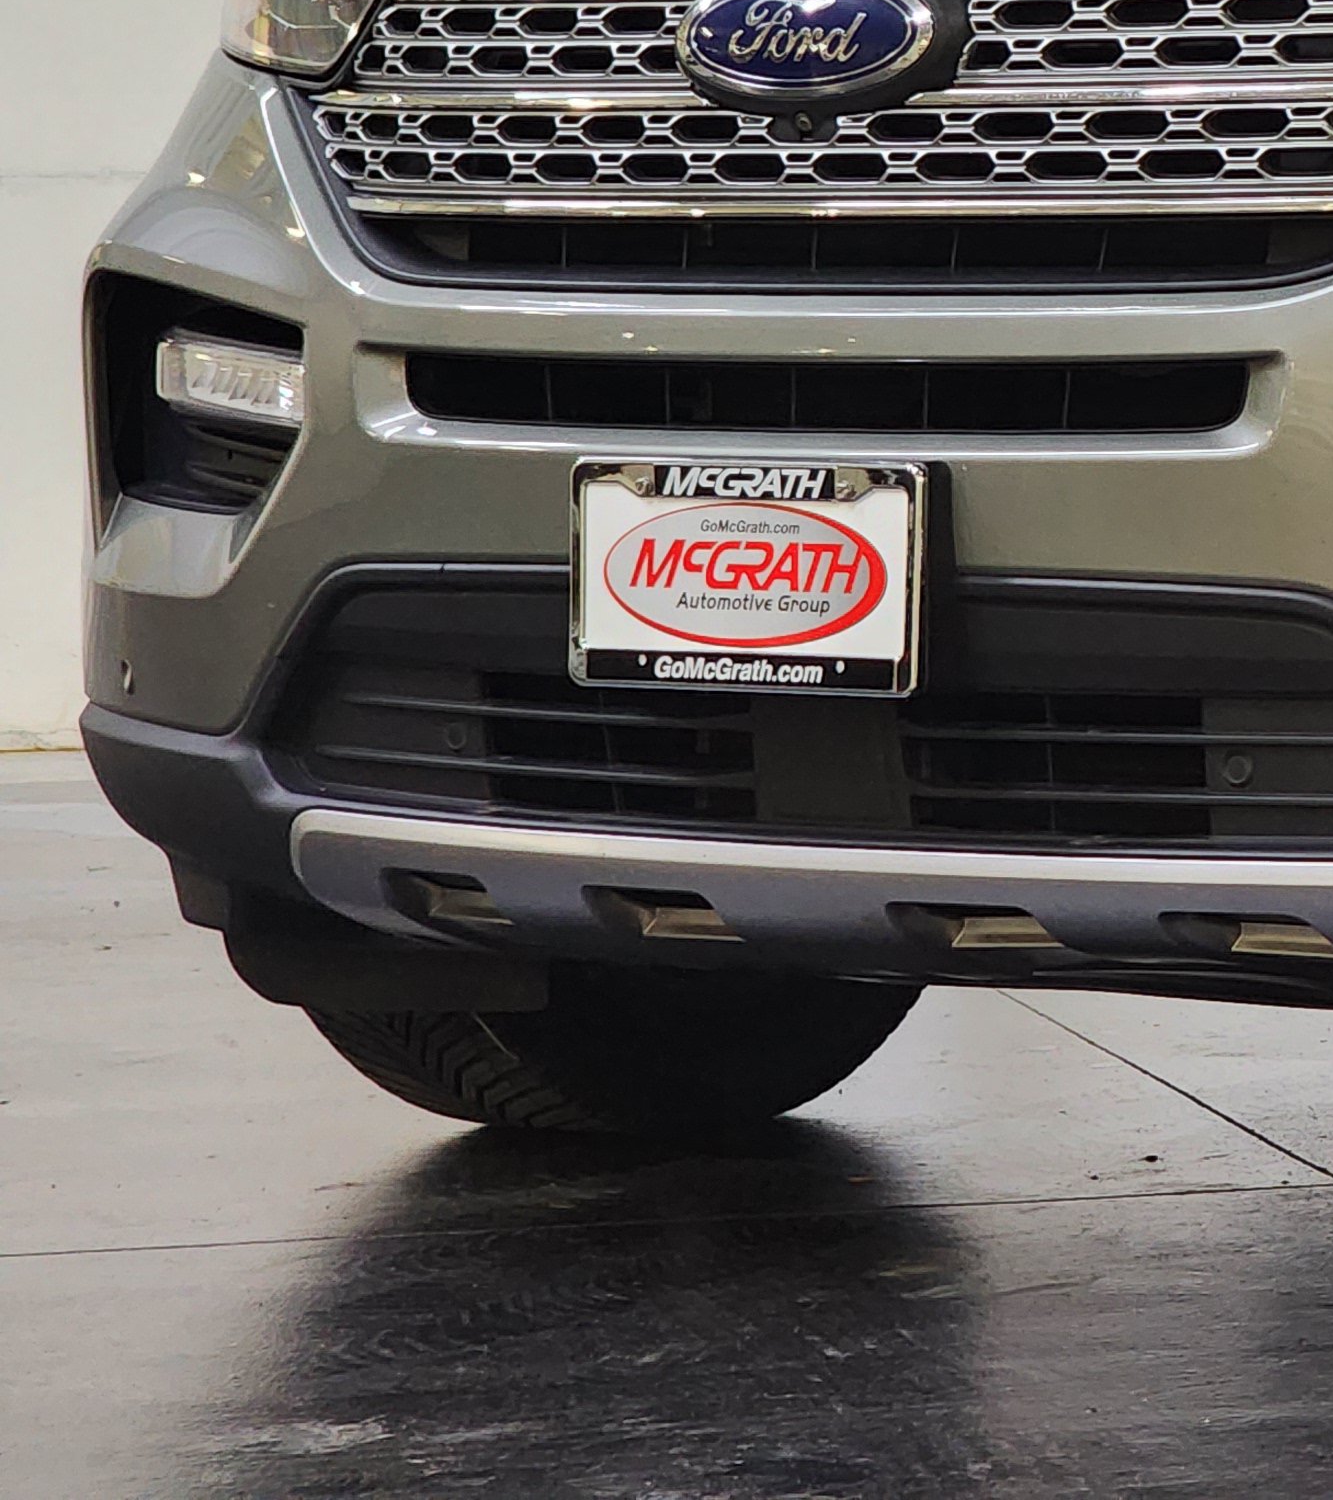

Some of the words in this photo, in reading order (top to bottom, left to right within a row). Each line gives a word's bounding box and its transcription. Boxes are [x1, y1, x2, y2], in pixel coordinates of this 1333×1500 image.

[699, 518, 801, 536] GoMcGrath.com
[675, 591, 773, 612] Automotive
[777, 594, 831, 618] Group
[653, 655, 824, 685] GoMcGrath.com
